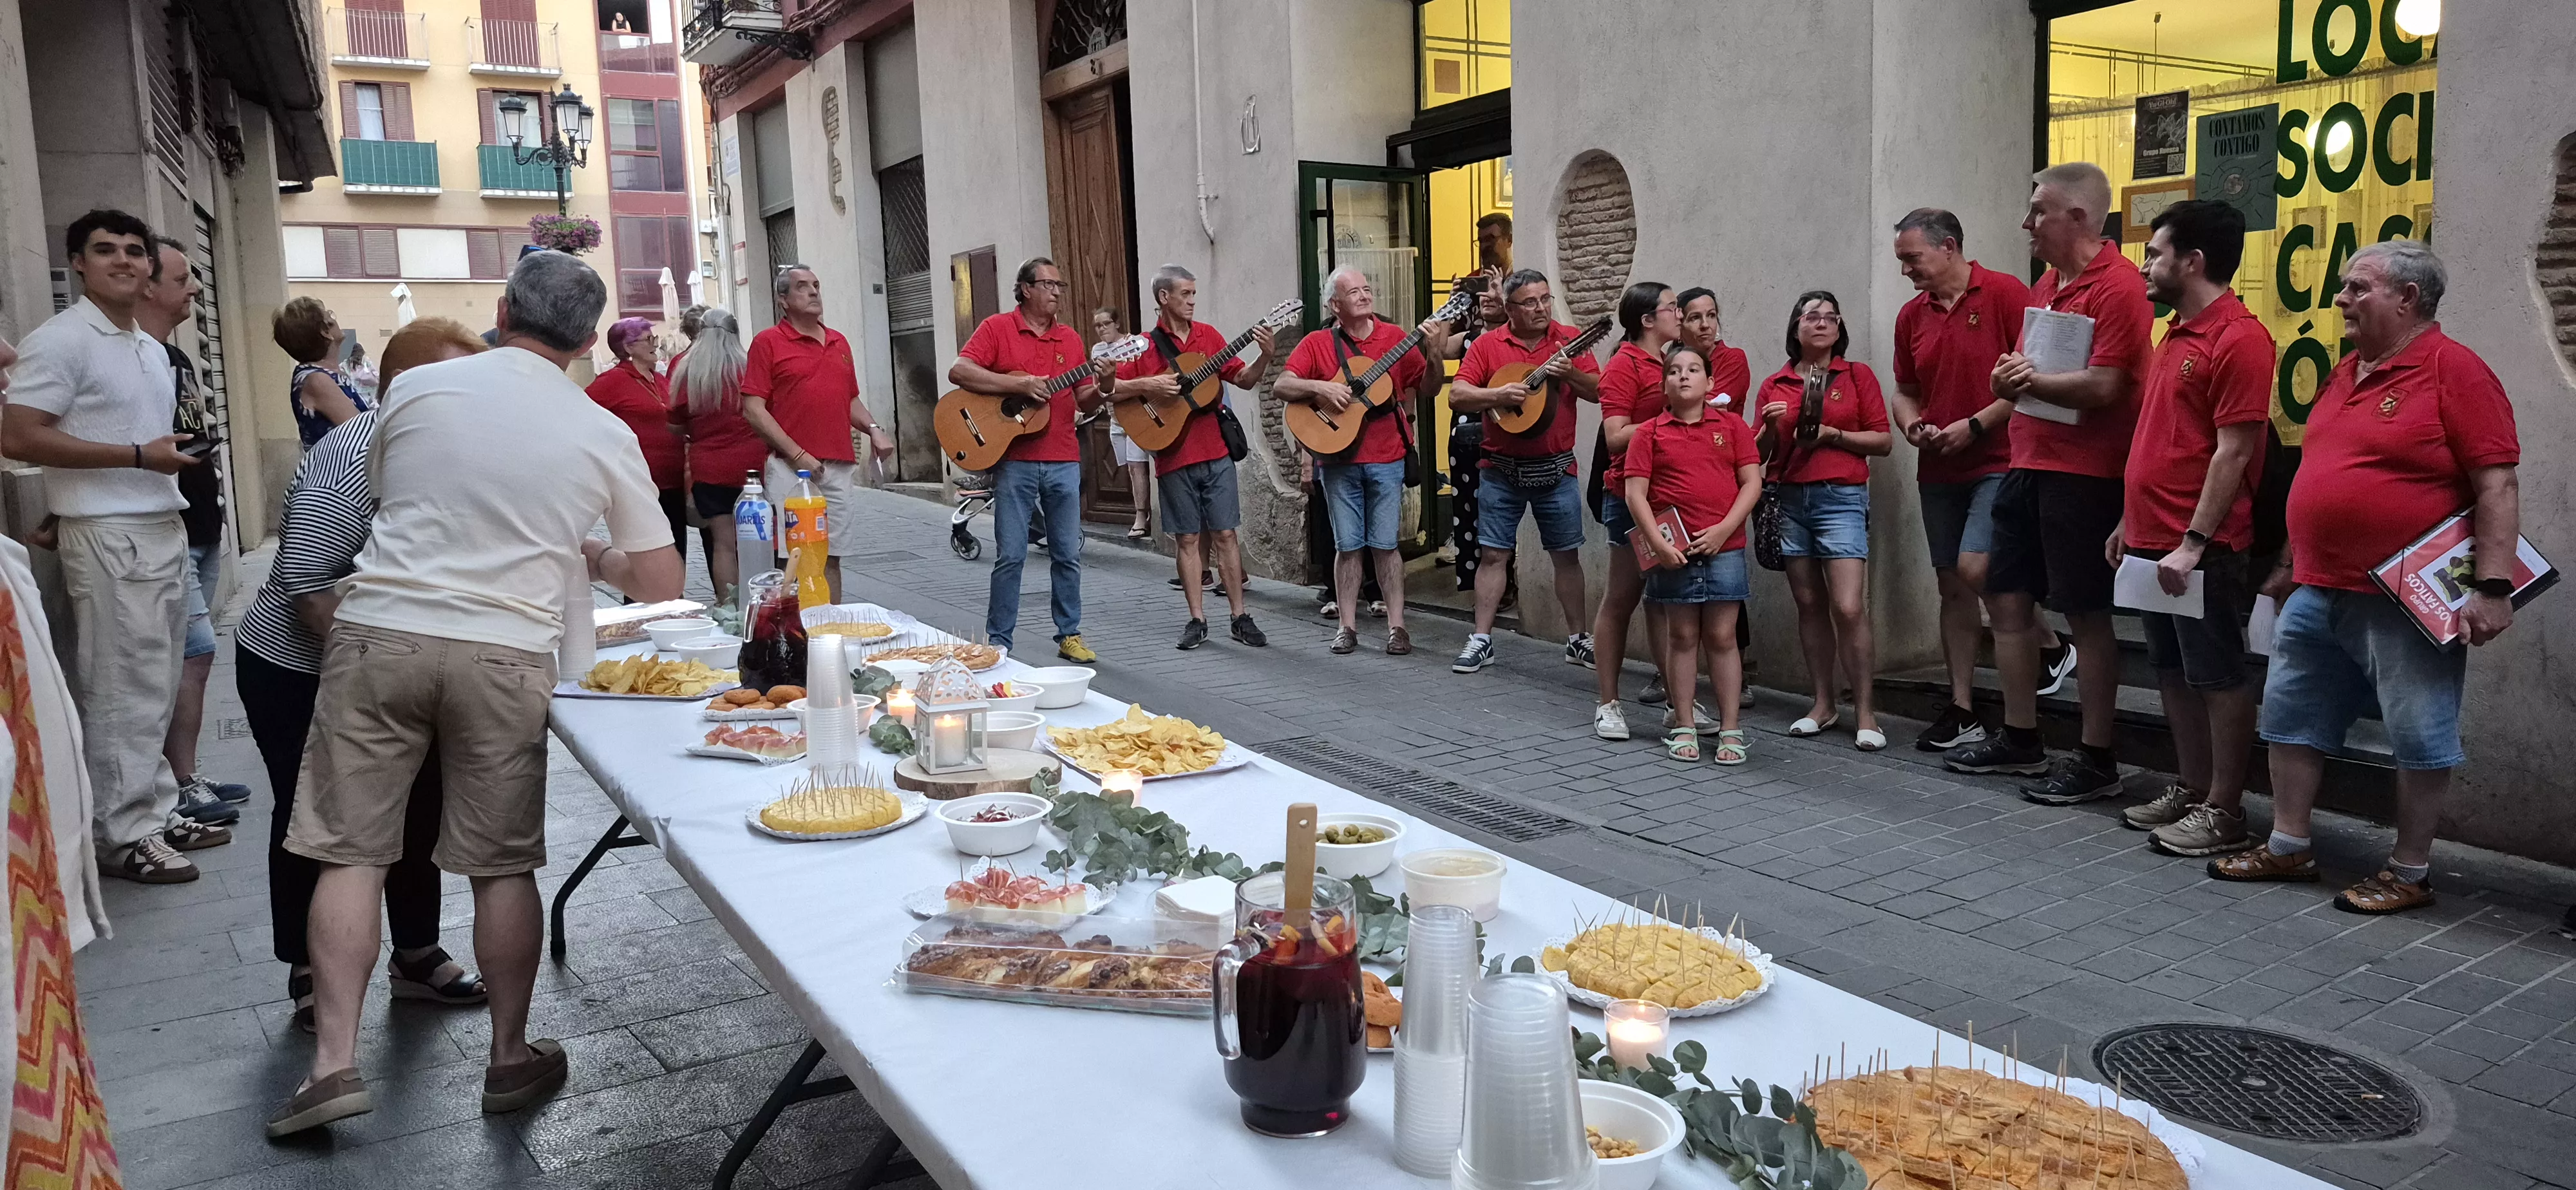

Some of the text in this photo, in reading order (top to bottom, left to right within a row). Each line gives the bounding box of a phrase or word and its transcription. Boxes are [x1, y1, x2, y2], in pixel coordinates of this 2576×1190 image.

[2277, 0, 2438, 84] LOC
[2209, 111, 2265, 138] CONTAMOS
[2214, 133, 2260, 157] CONTIGO
[2404, 573, 2439, 609] FATICOS
[2409, 594, 2430, 614] GRUPO
